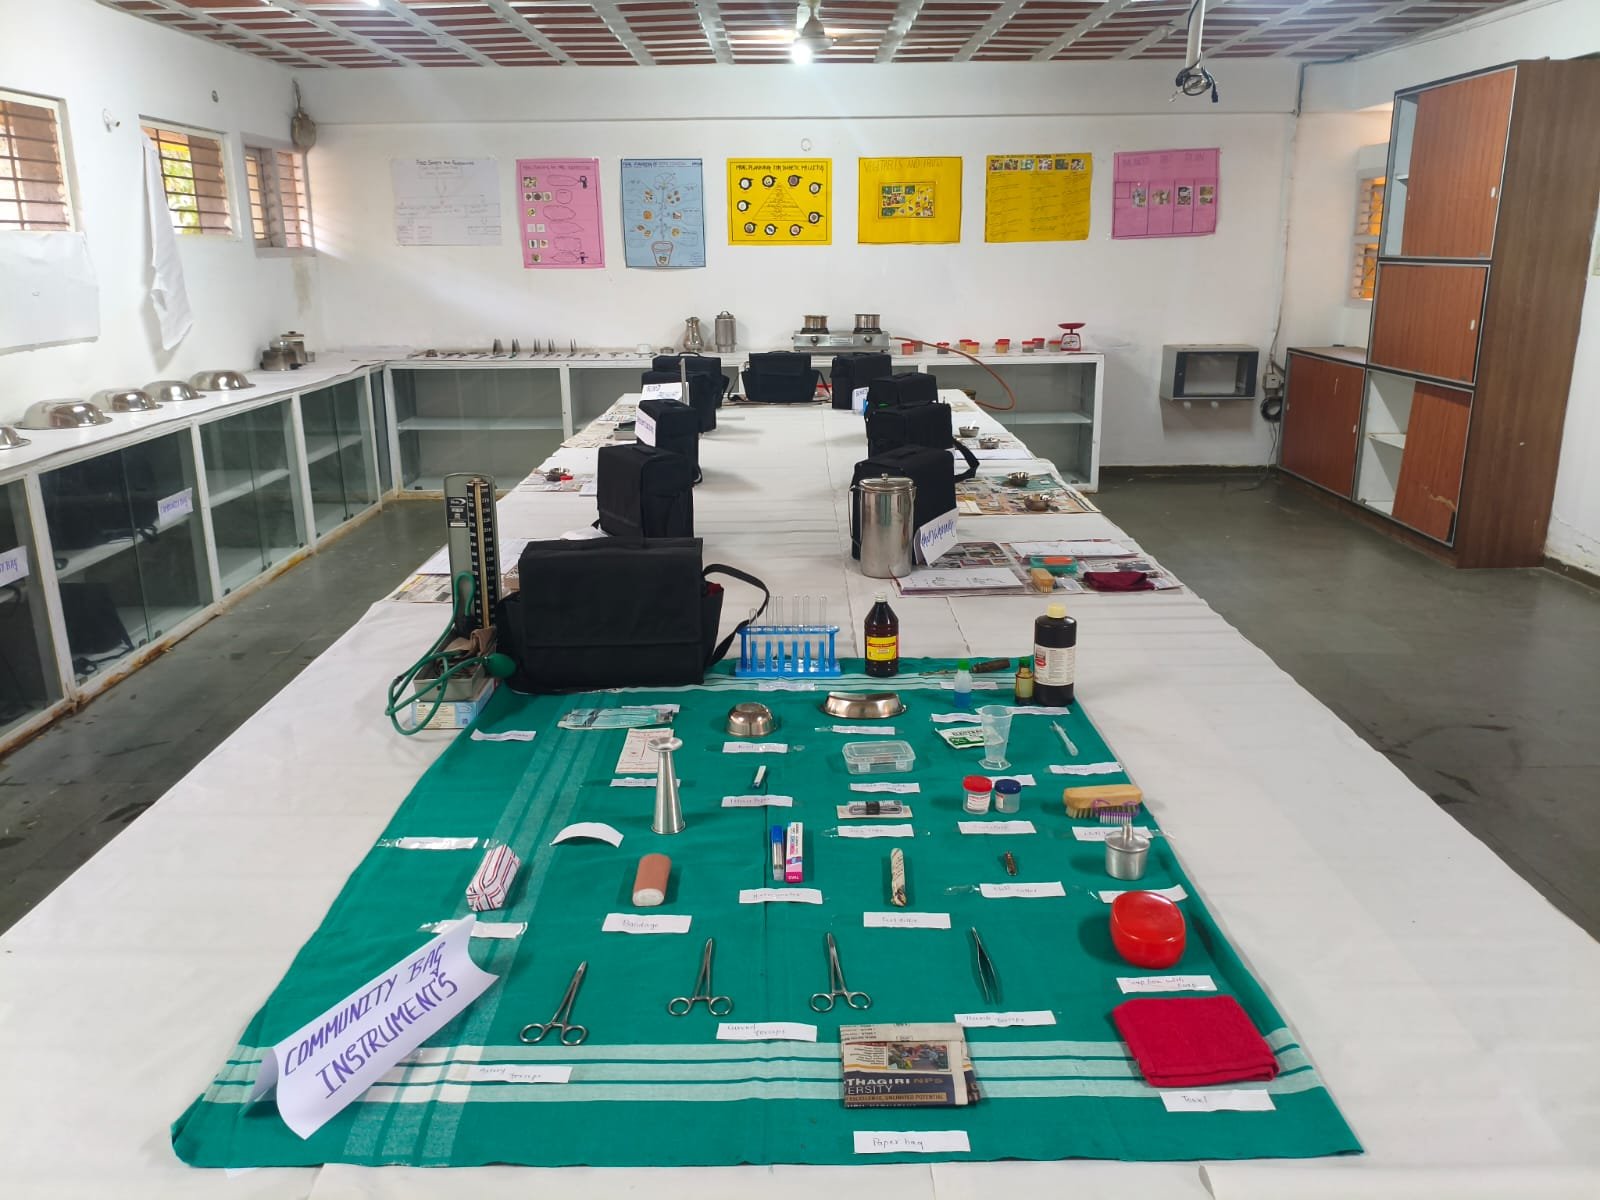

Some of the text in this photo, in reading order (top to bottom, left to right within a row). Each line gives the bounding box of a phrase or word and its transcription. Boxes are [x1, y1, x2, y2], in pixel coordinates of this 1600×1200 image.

[284, 941, 446, 1077] COMMUNITY BAG
[844, 1078, 911, 1087] THAGIRI
[845, 1085, 893, 1096] ERSITY
[872, 1137, 899, 1149] Paper
